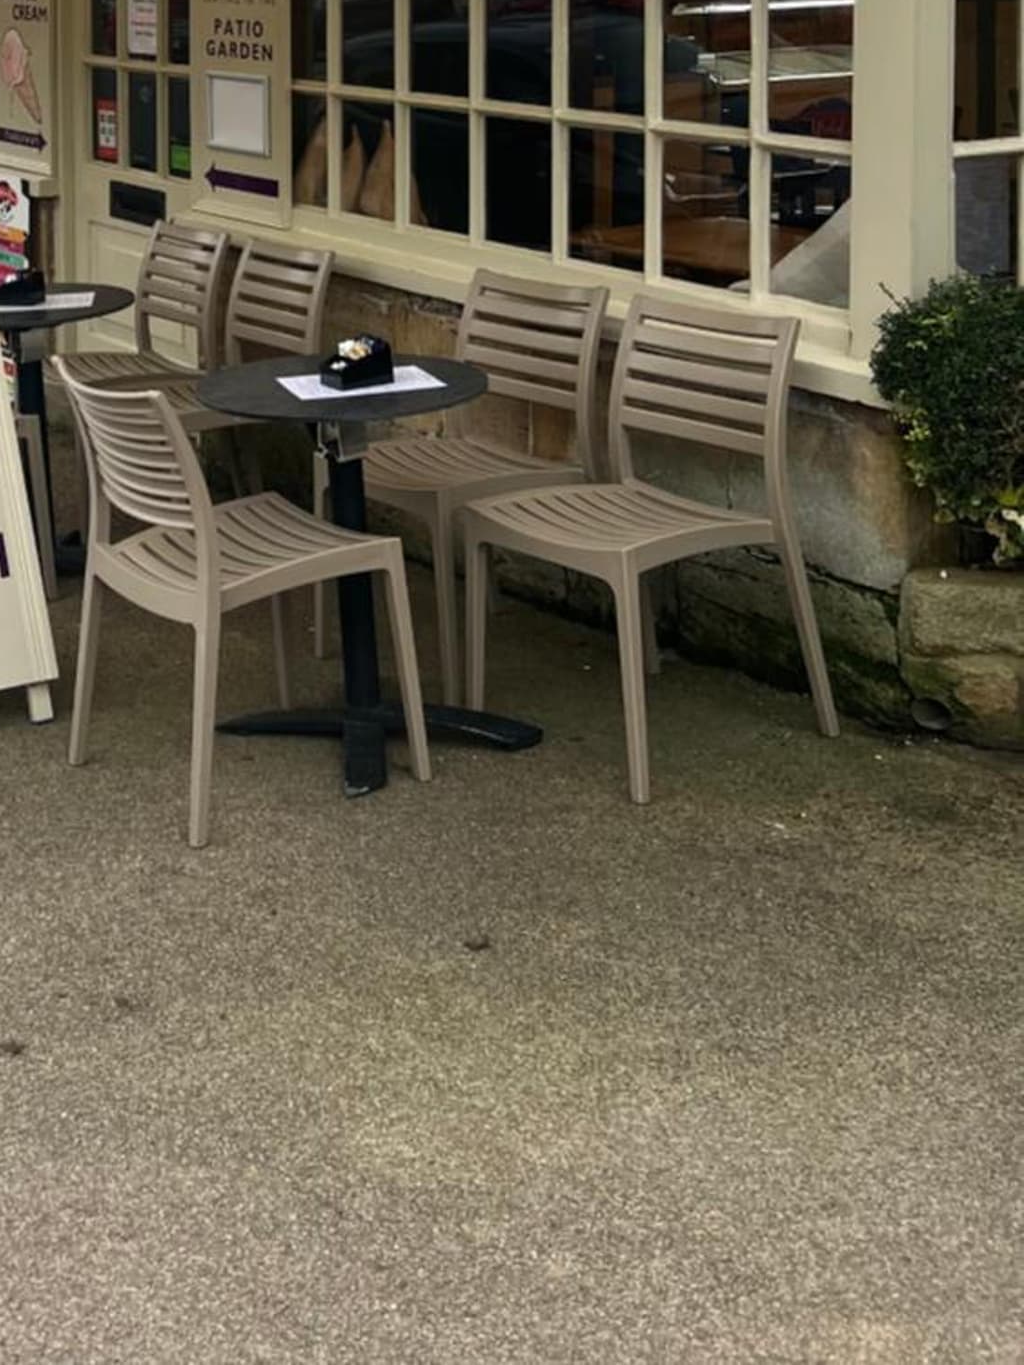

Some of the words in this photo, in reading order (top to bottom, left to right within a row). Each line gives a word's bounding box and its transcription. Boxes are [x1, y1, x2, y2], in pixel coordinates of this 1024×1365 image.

[12, 4, 48, 22] CREAM
[214, 18, 264, 38] PATIO
[205, 39, 272, 62] GARDEN
